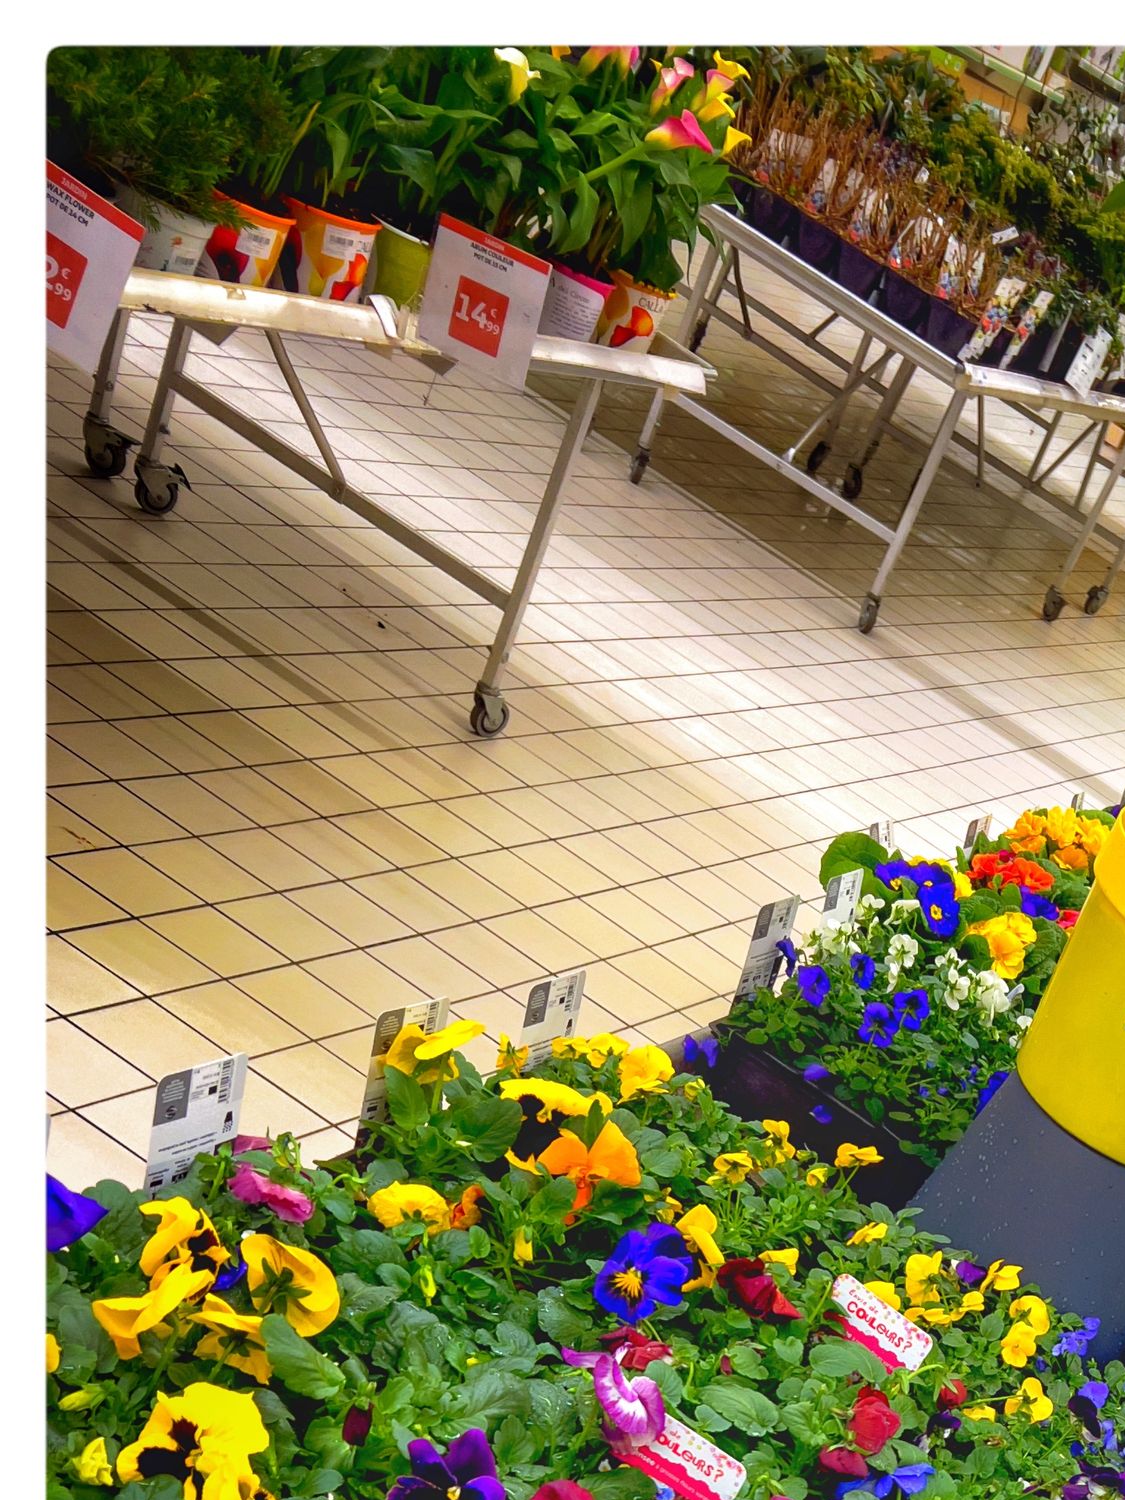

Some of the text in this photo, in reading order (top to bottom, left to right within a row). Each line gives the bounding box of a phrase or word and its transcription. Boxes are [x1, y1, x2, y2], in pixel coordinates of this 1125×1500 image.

[61, 177, 88, 200] JARDIN
[64, 193, 95, 219] FLOWER
[656, 1432, 725, 1483] OULEURS?
